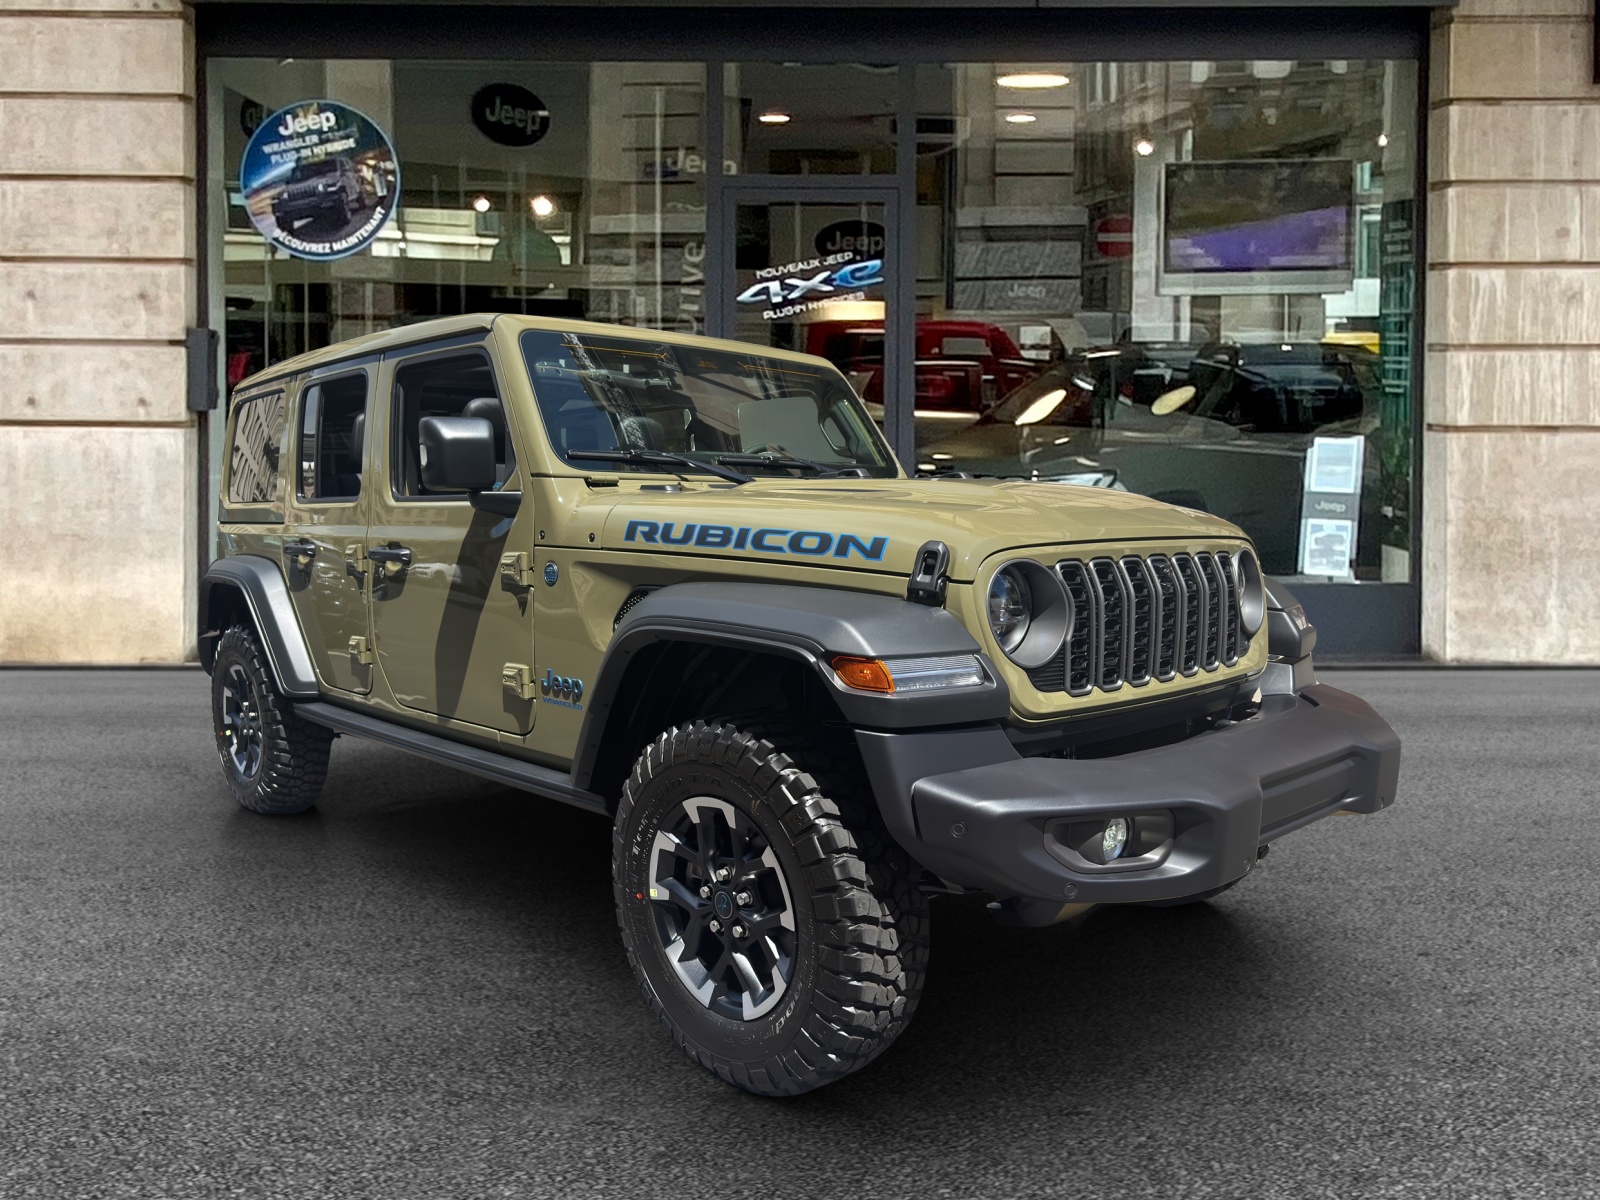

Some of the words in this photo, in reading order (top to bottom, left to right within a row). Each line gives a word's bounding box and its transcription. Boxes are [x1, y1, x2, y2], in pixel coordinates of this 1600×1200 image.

[278, 111, 337, 136] Jeep
[485, 96, 541, 135] Jeep
[262, 134, 320, 154] WRANGLER
[332, 206, 386, 251] MAINTENANT
[826, 230, 885, 255] Jeep
[755, 258, 821, 280] NOUVEAUX
[823, 251, 854, 266] JEEP
[1315, 500, 1346, 513] Jeep
[624, 519, 890, 562] RUBICON
[541, 668, 584, 705] Jeep
[542, 696, 584, 711] WRANGLER
